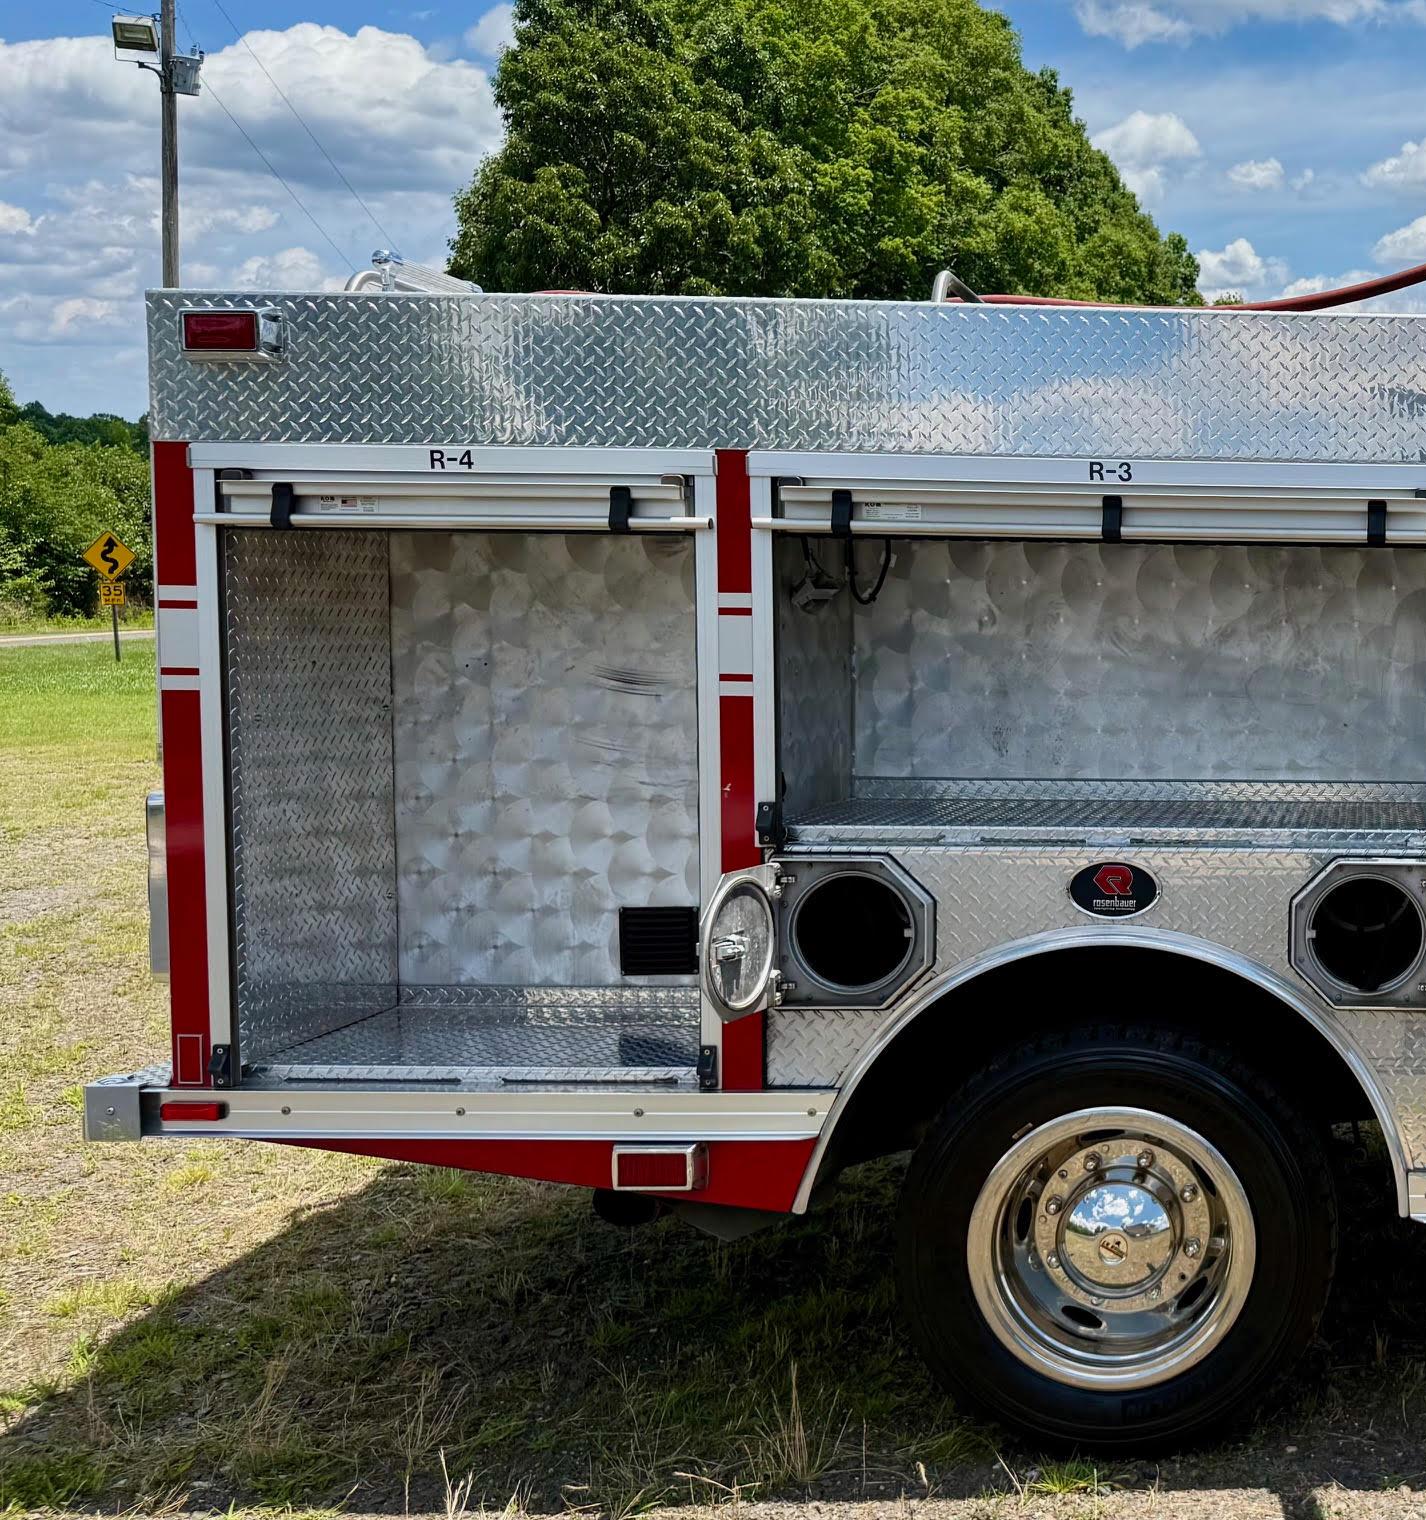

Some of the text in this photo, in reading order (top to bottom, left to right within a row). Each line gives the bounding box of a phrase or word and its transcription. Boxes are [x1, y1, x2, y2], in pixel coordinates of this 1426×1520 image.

[429, 449, 475, 470] R-4
[1089, 461, 1133, 482] R-3
[102, 585, 123, 597] 35
[1092, 895, 1137, 908] rosenbauer
